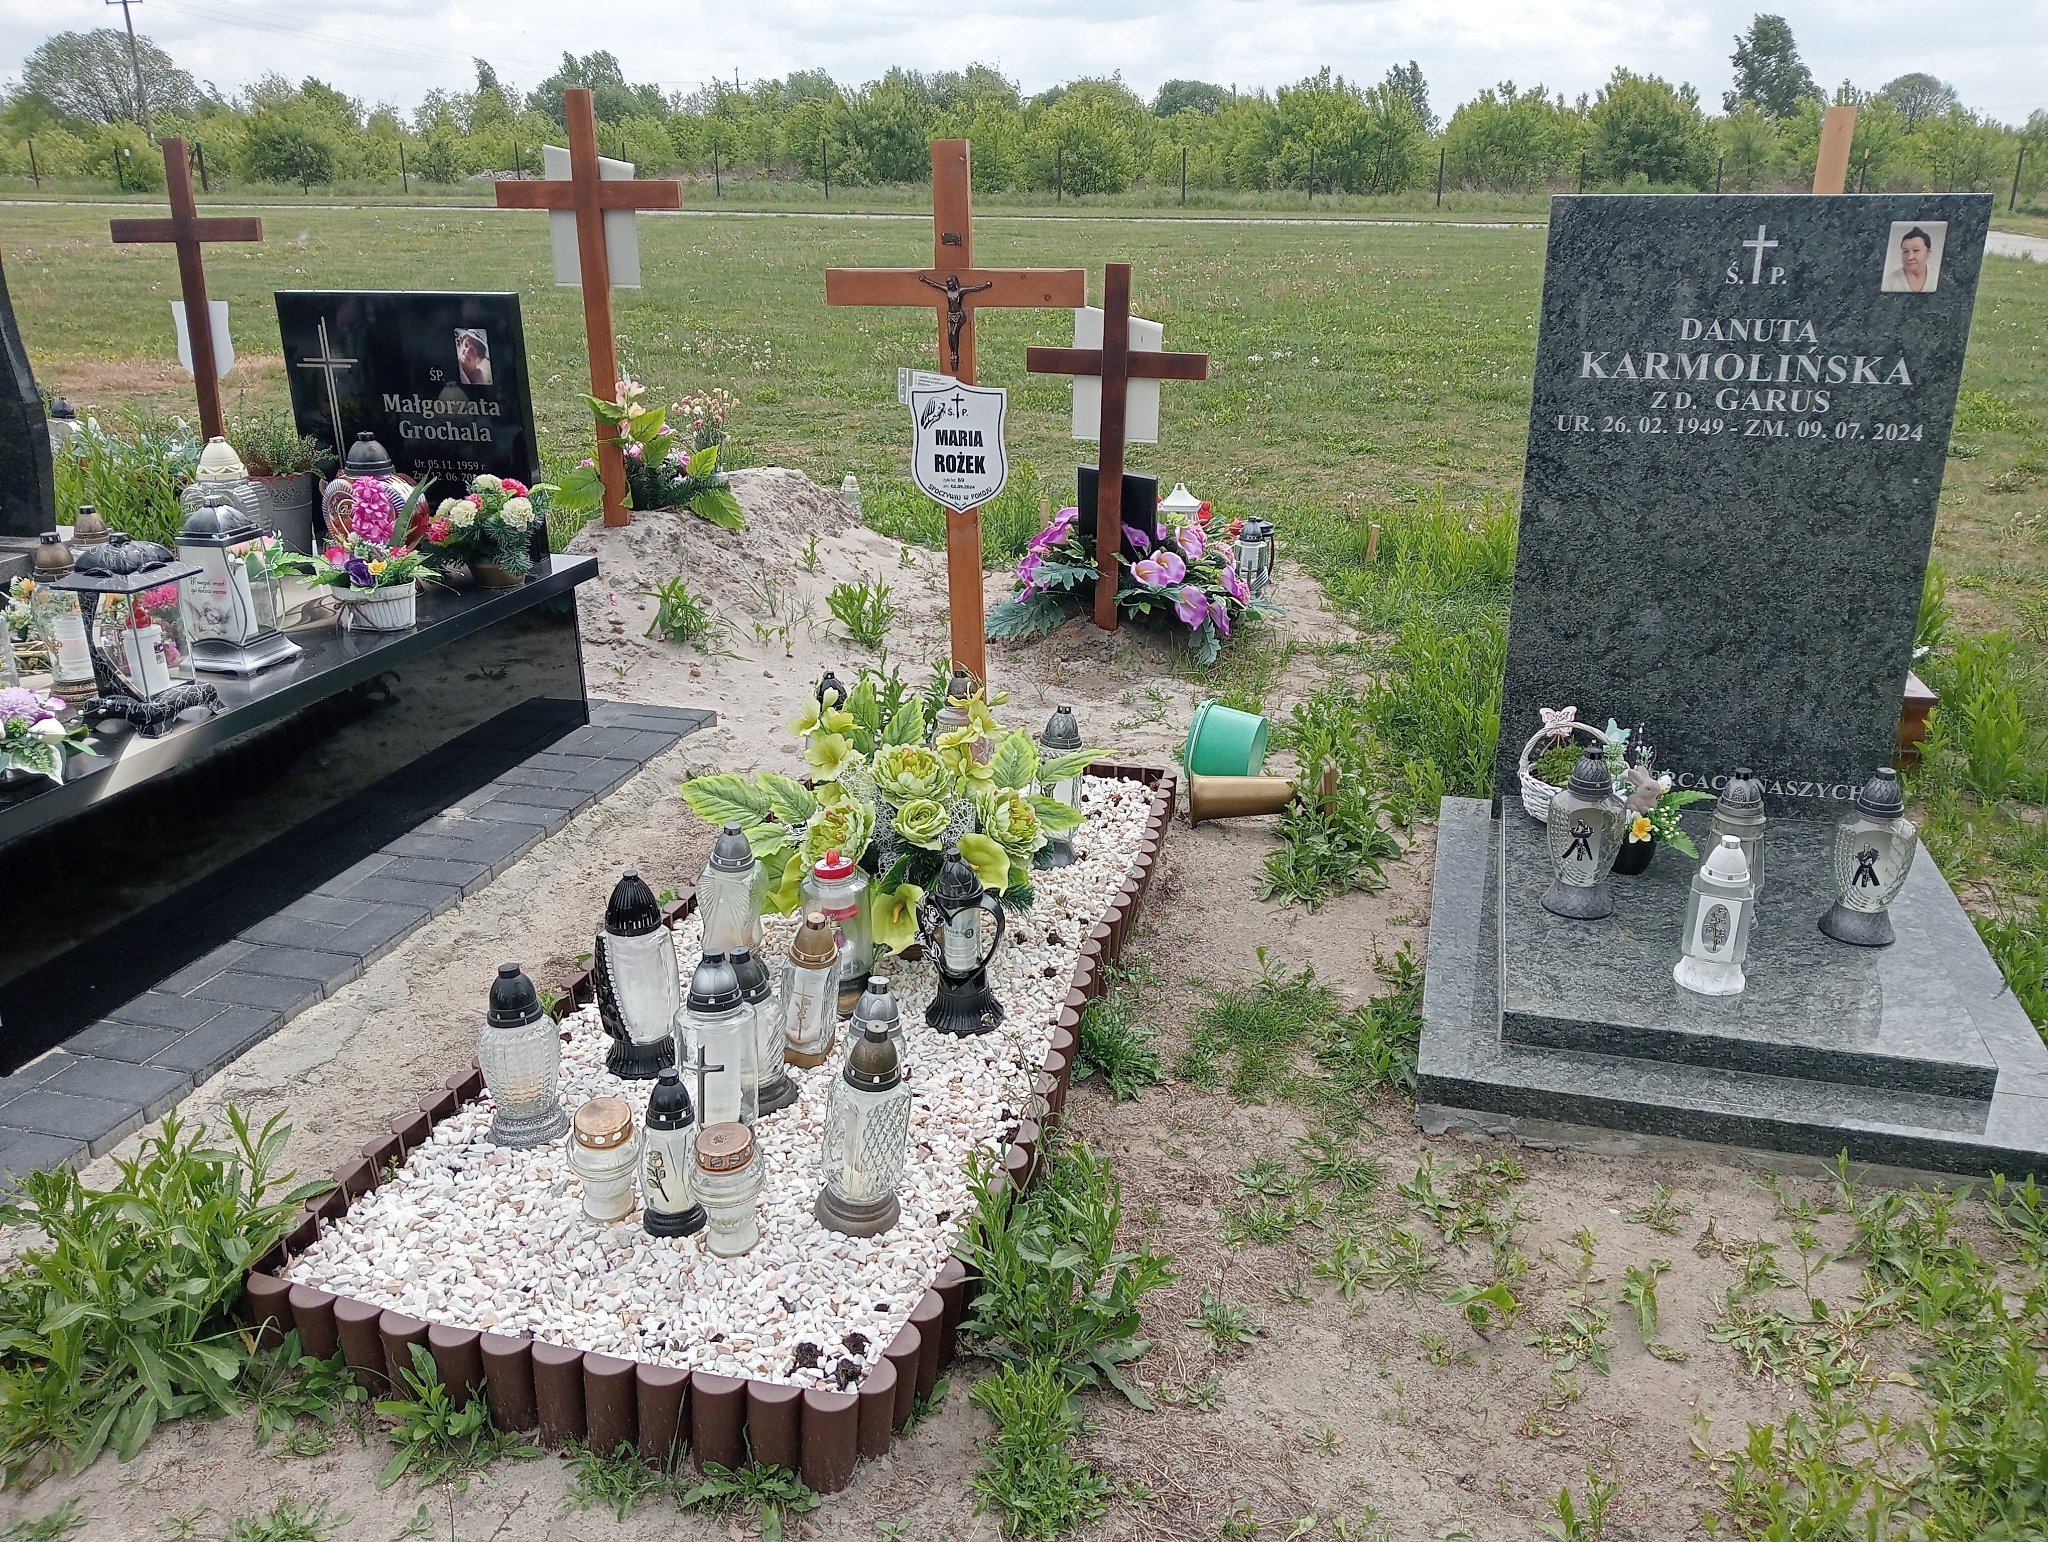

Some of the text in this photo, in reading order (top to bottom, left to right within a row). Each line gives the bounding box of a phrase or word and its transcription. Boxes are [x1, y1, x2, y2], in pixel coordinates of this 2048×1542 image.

[1725, 261, 1787, 286] Ś. P.
[1680, 317, 1819, 343] DANUTA
[1580, 346, 1913, 386] KARMOLIŃSKA
[382, 393, 501, 419] Małgorzata
[1715, 387, 1831, 414] GARUS
[399, 420, 492, 442] Grochala
[935, 429, 984, 447] MARIA
[1557, 414, 1595, 432] UR.
[1602, 415, 1631, 433] 26.
[1639, 416, 1668, 434] 02.
[1676, 417, 1724, 435] 1949
[1744, 419, 1789, 437] ZM.
[1797, 420, 1827, 438] 09.
[1835, 421, 1865, 440] 07.
[1872, 423, 1923, 441] 2024
[457, 460, 479, 470] 1959
[934, 451, 986, 474] ROŻEK
[970, 486, 993, 500] POKOJU
